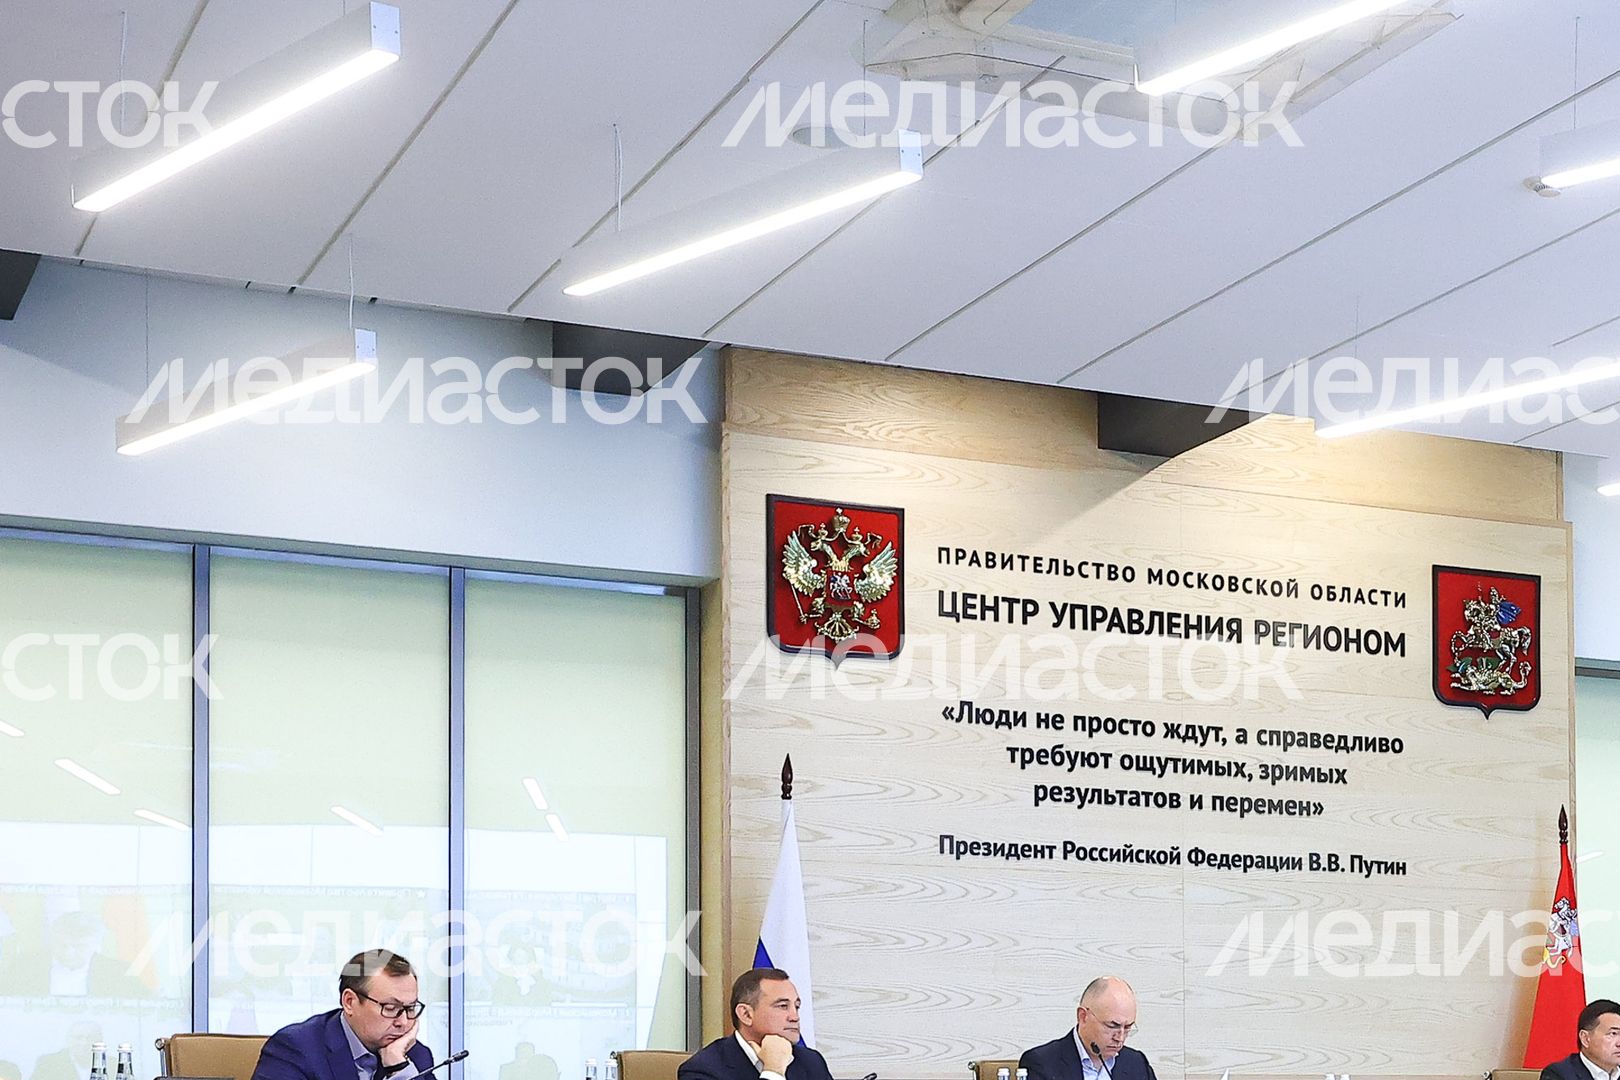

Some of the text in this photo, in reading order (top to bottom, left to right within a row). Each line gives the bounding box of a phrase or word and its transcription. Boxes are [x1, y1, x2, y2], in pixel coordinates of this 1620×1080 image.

[937, 546, 1407, 610] ПРАВИТЕЛЬСТВО МОСКОВСКОЙ ОБЛАСТИ
[938, 589, 1406, 658] ЦЕНТР УПРАВЛЕНИЯ РЕГИОНОМ
[941, 700, 1404, 755] «Люди не просто ждут, а справедливо
[1005, 743, 1348, 786] требуют ощутимых, зримых
[1033, 781, 1325, 819] результатов и перемен»
[938, 834, 1407, 879] Президент Российской Федерации В.В. Путин
